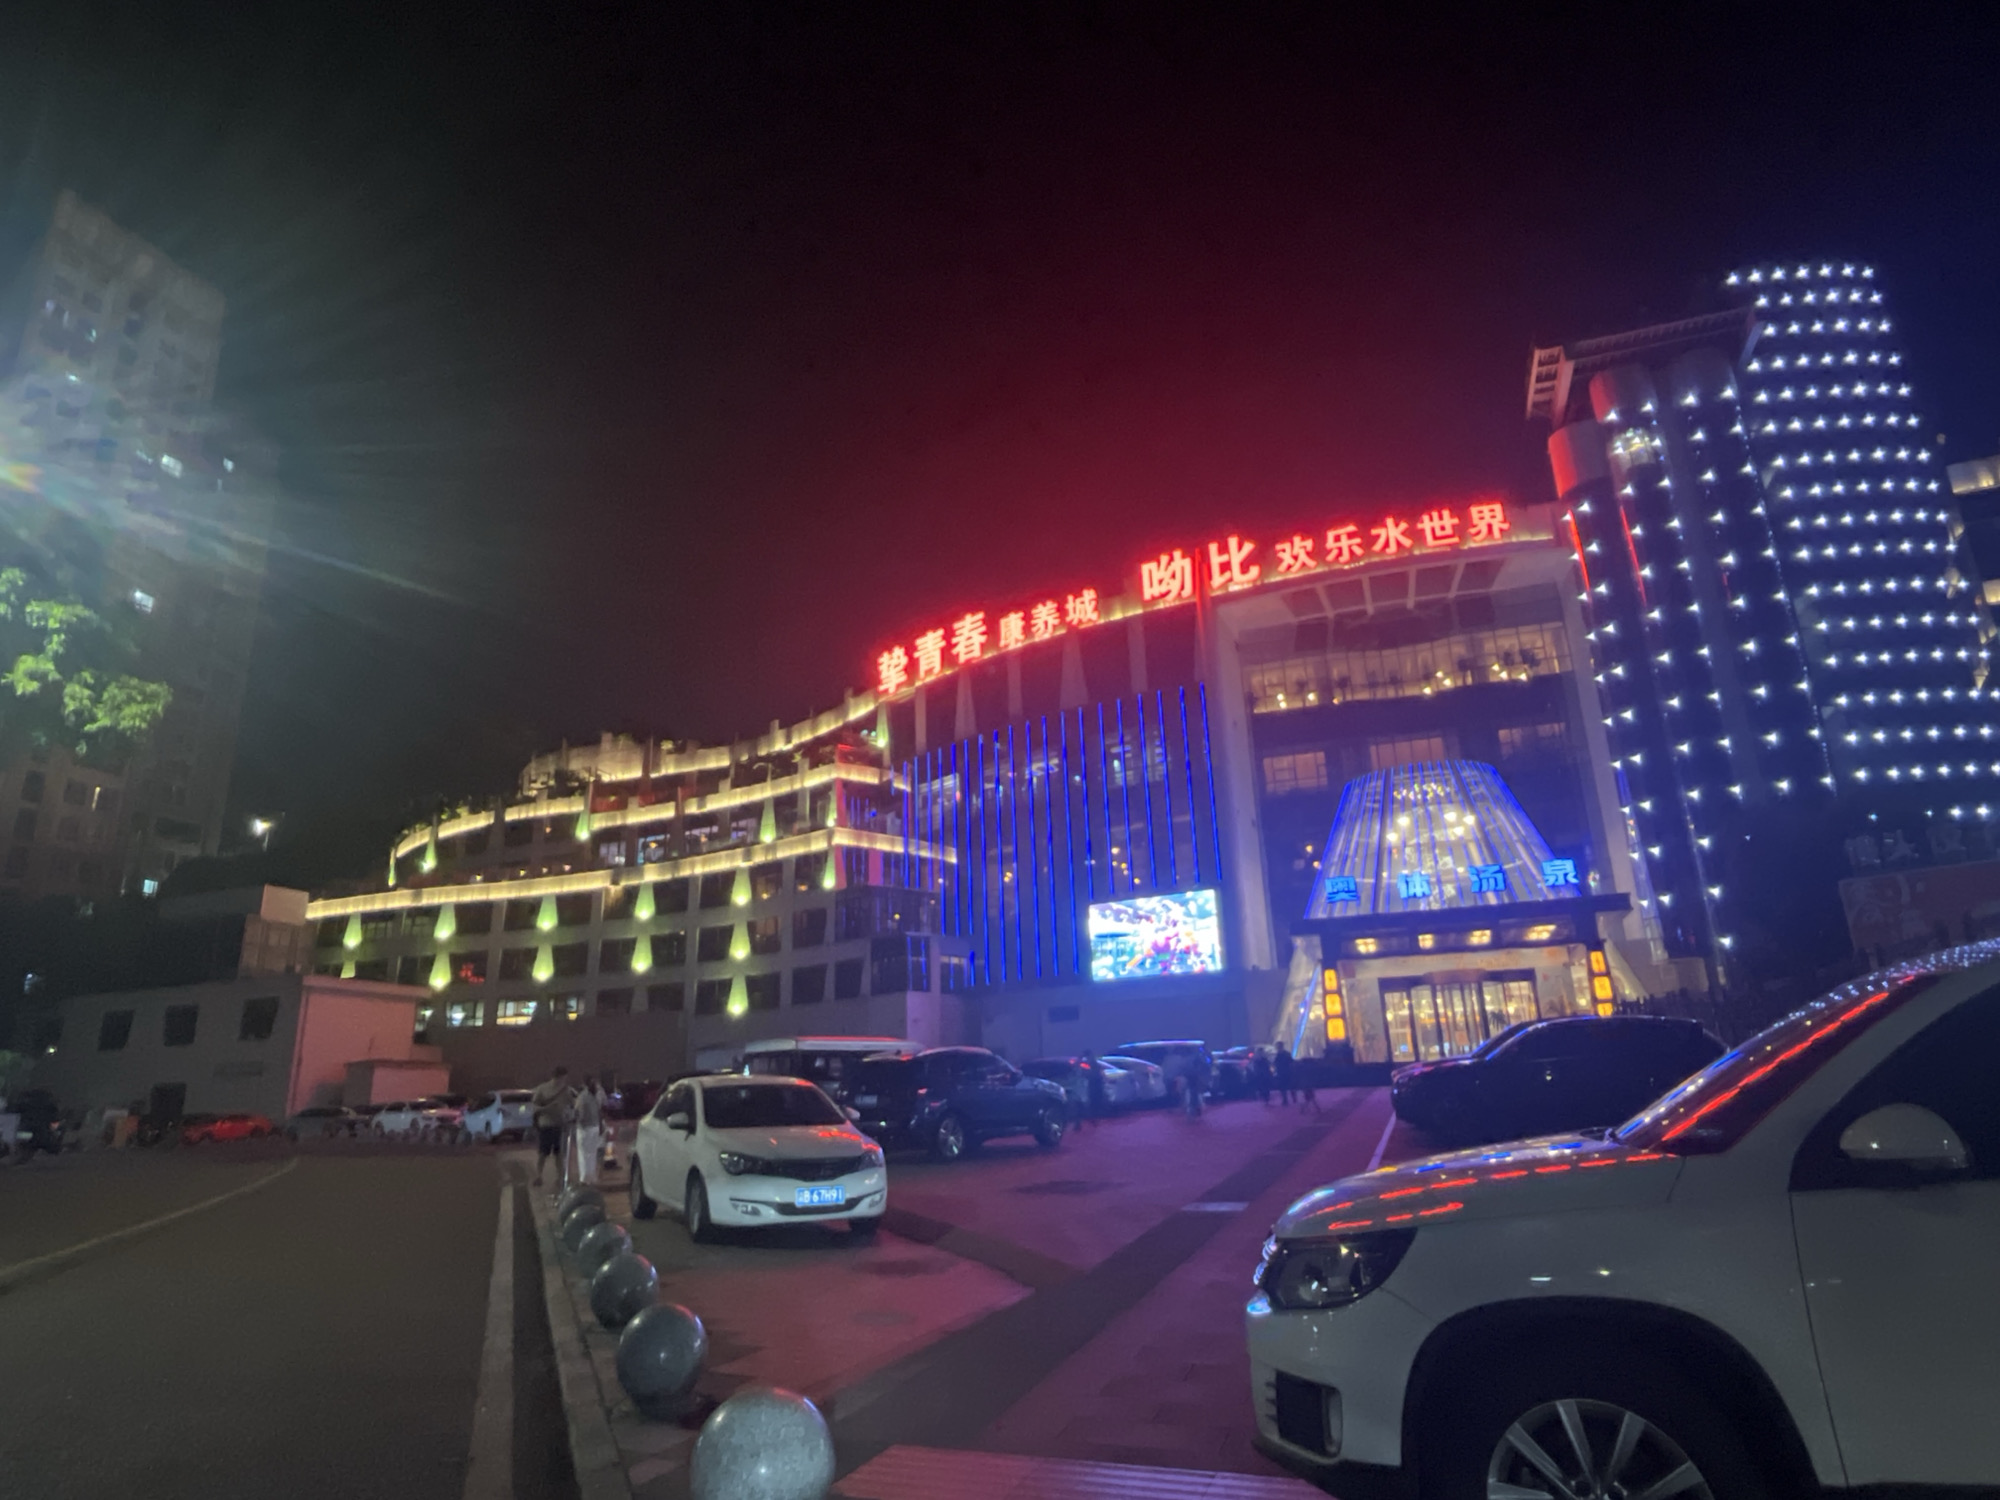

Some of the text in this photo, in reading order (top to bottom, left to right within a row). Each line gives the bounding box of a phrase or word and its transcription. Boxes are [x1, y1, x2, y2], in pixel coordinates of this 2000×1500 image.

[1141, 502, 1510, 601] 呦比 欢乐水世界
[877, 588, 1098, 694] 挚青春 康养城
[1325, 858, 1579, 903] 奥体汤泉
